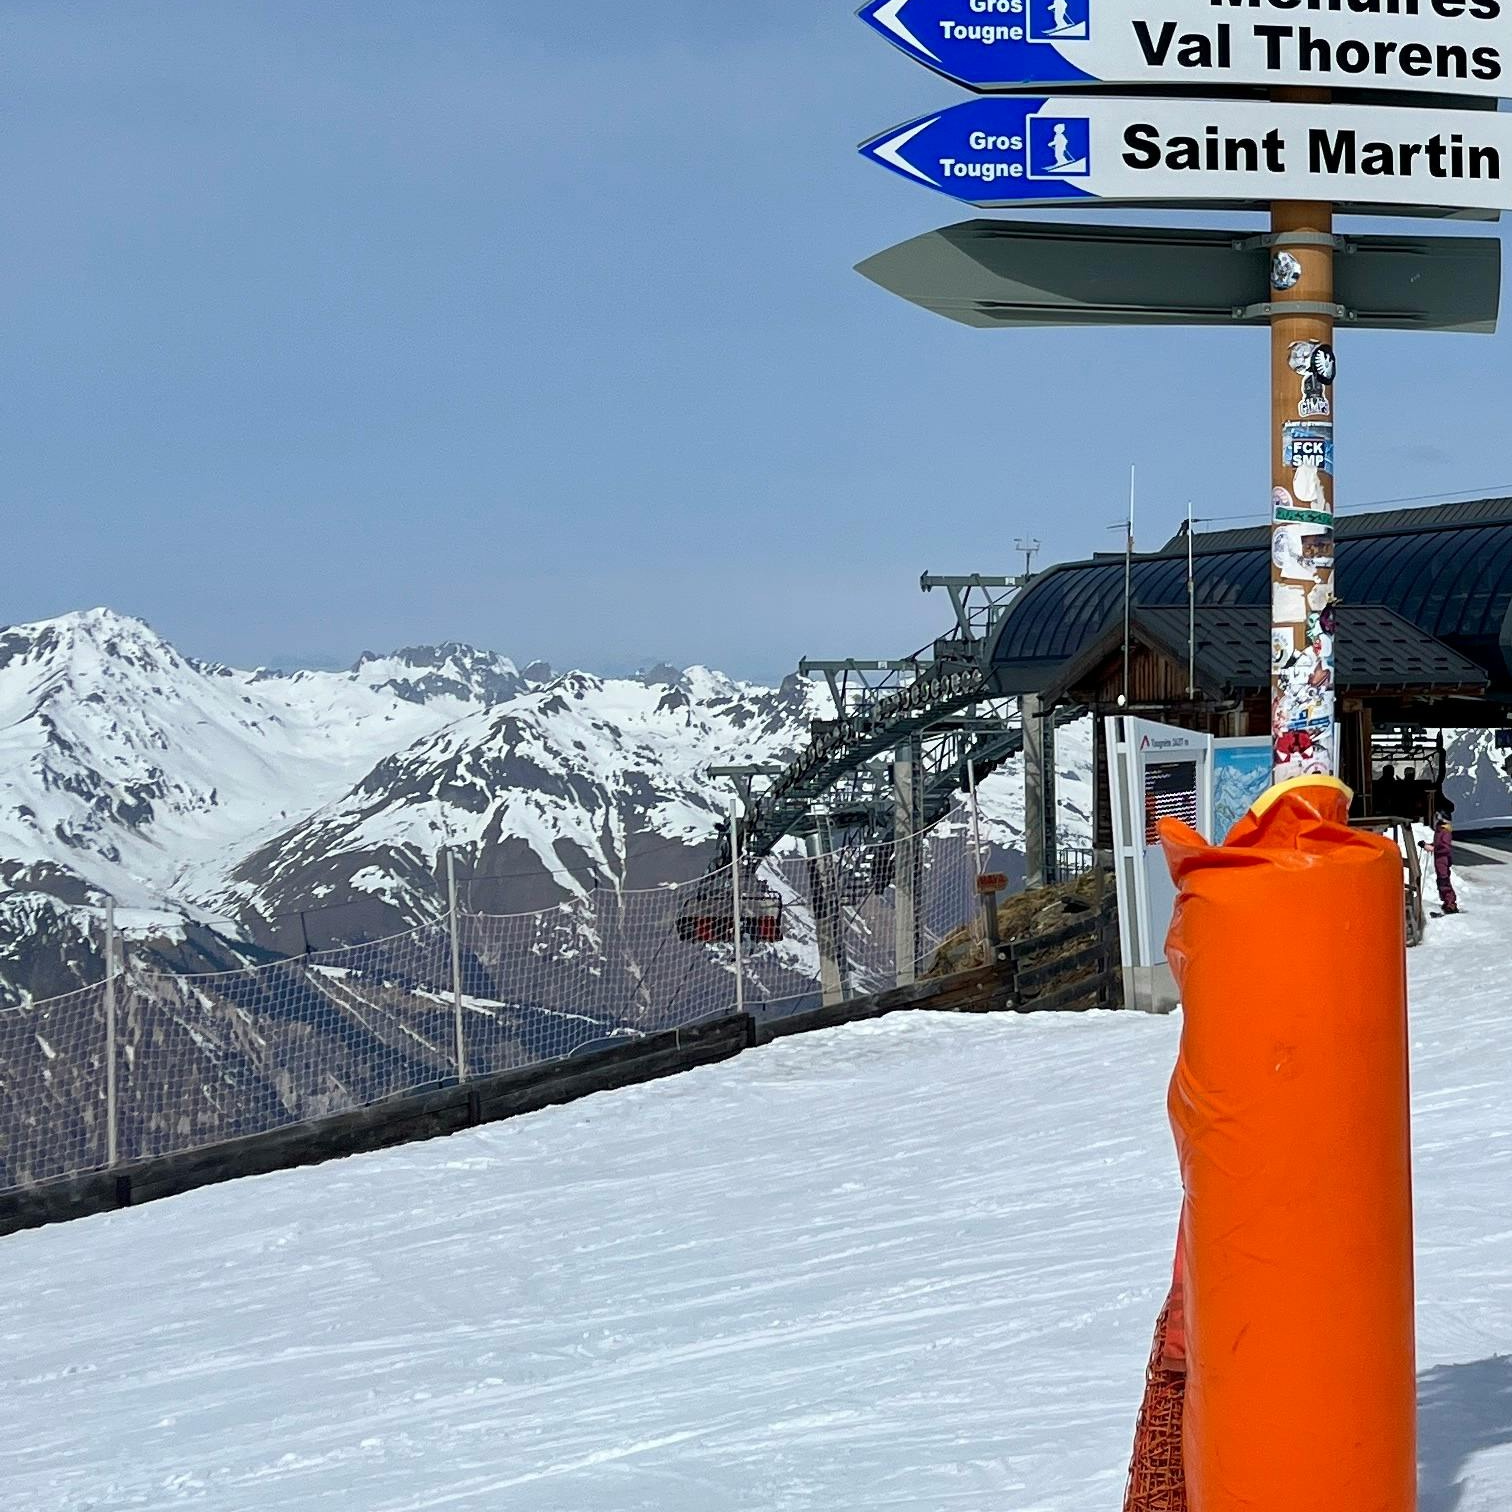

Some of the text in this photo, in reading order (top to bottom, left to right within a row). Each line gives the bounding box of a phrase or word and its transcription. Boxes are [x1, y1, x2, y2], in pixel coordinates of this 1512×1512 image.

[939, 21, 1023, 44] Tougne
[1131, 20, 1502, 81] Val Thorens
[969, 131, 1023, 150] Gros
[1121, 123, 1500, 180] Saint Martin
[939, 158, 1023, 181] Tougne
[1292, 441, 1324, 454] FCK
[1292, 455, 1324, 467] SMP
